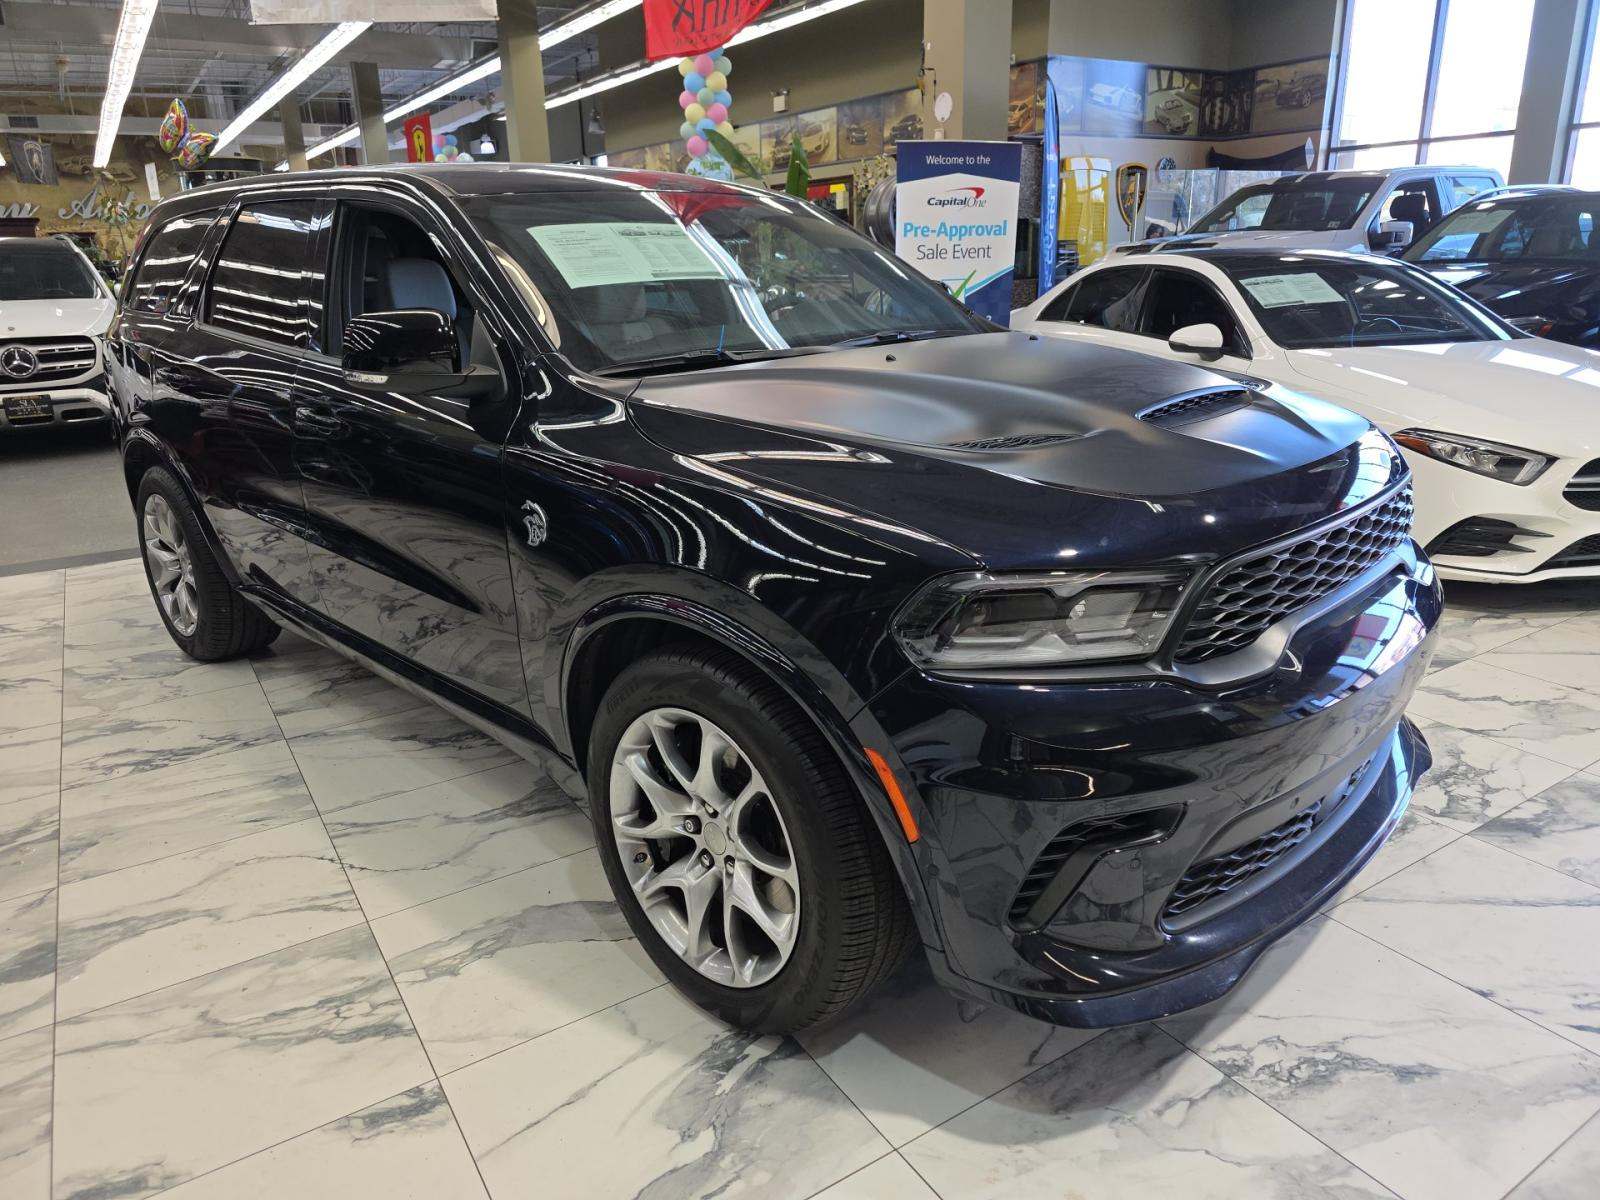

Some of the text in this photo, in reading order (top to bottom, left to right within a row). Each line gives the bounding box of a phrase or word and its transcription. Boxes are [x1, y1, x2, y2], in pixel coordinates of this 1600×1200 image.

[926, 155, 991, 165] Welcome to the
[903, 219, 1008, 241] Pre-Approval
[916, 243, 992, 260] Sale Event
